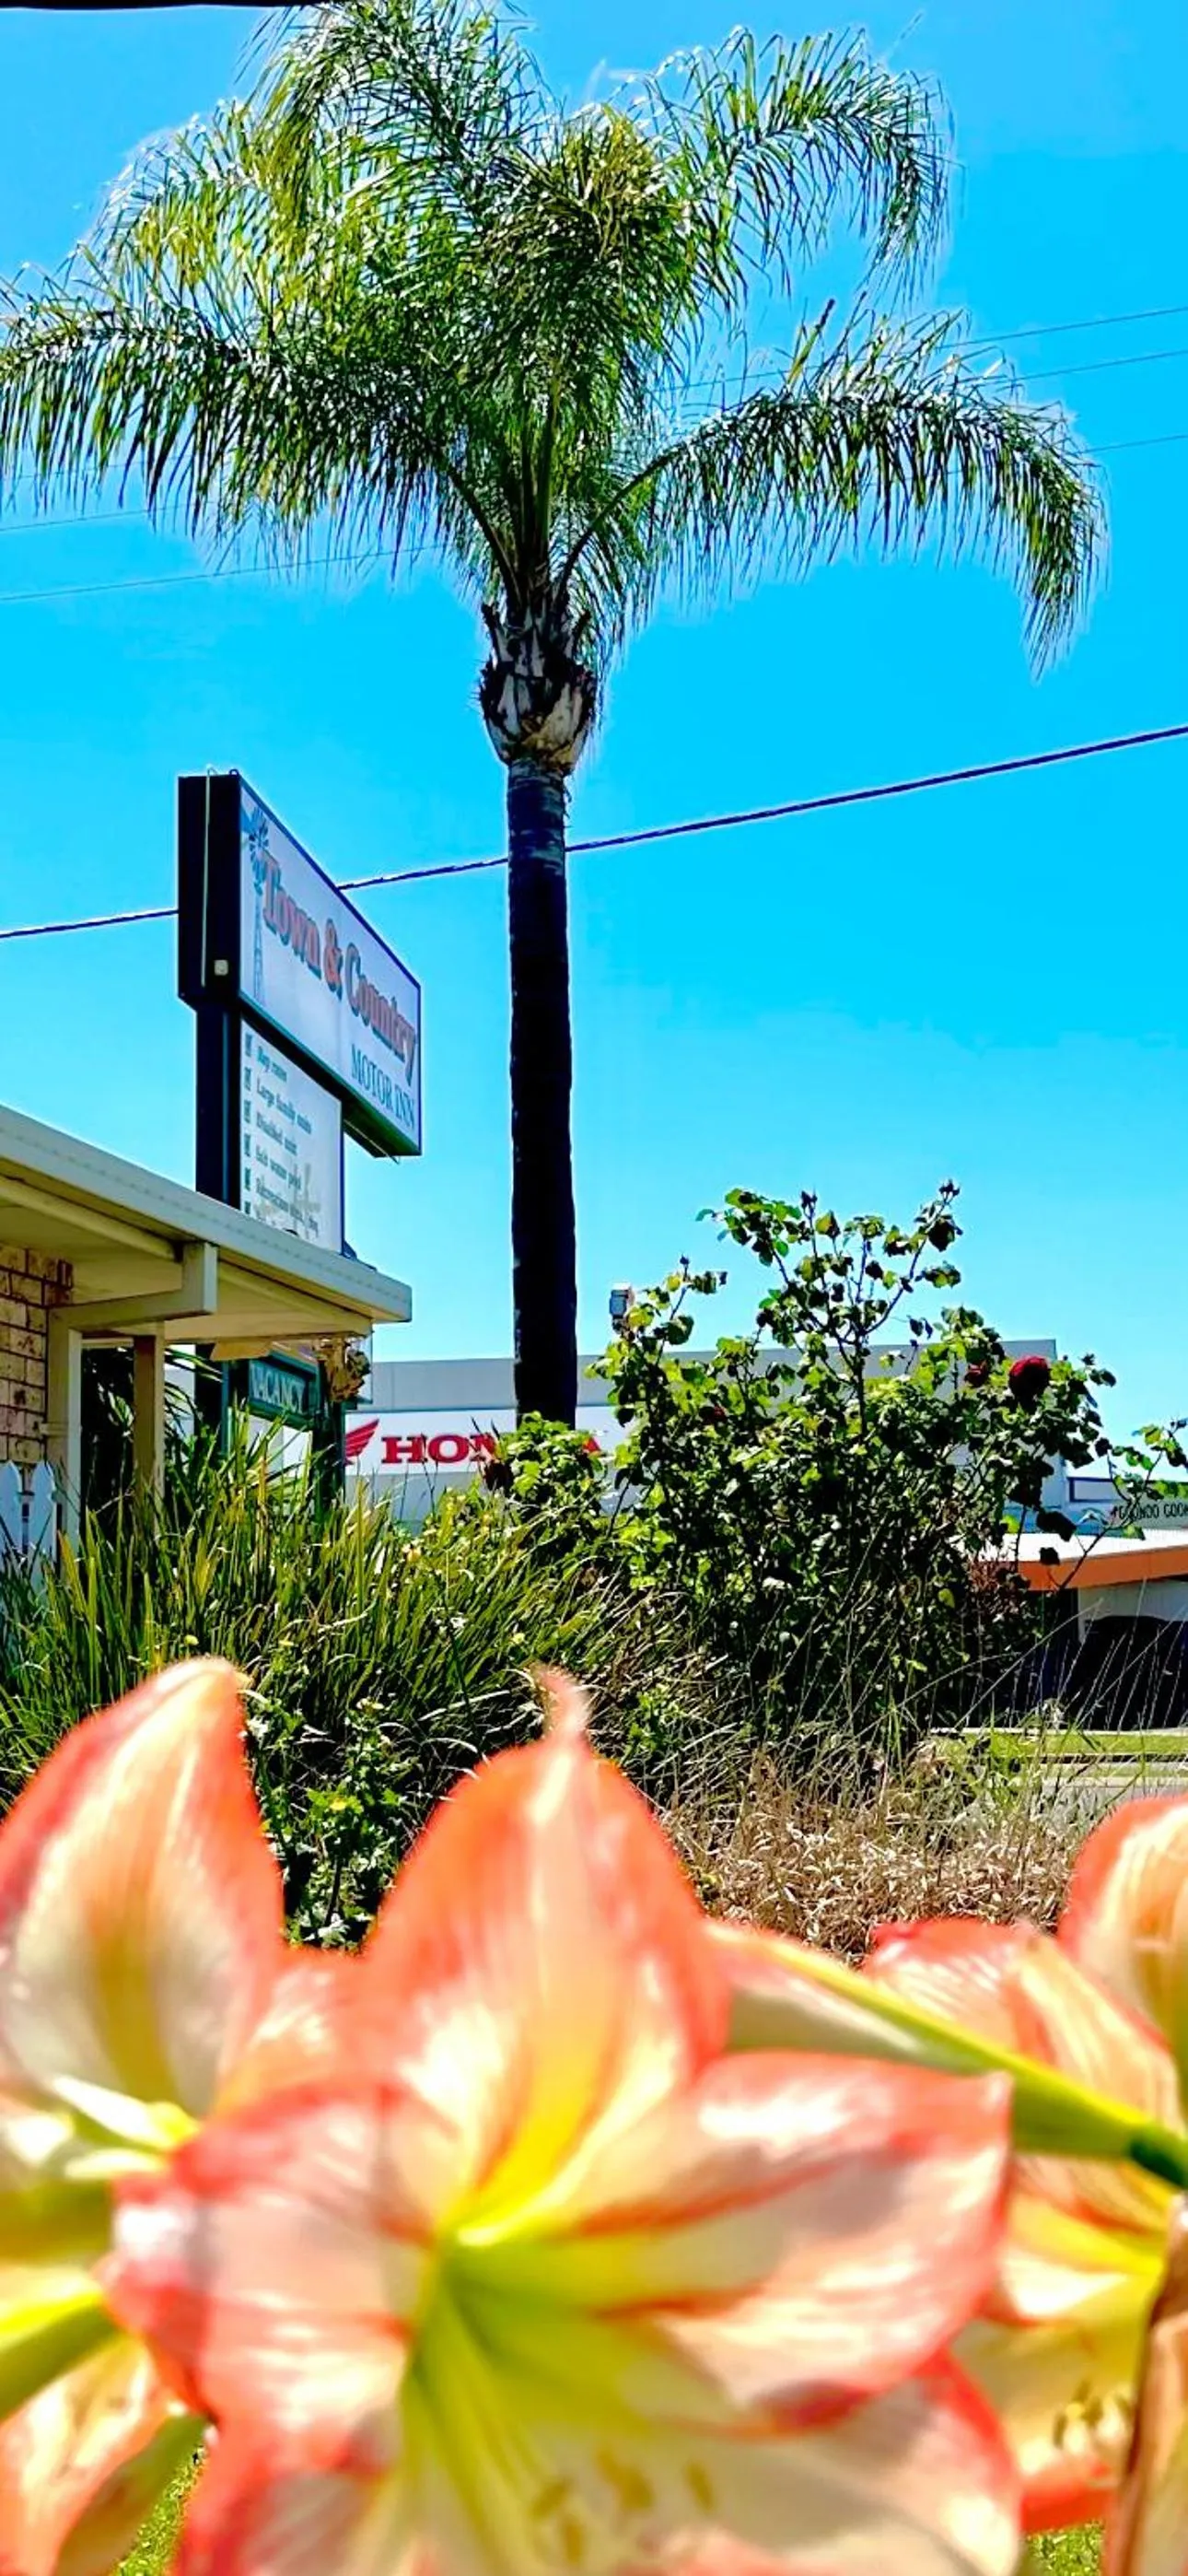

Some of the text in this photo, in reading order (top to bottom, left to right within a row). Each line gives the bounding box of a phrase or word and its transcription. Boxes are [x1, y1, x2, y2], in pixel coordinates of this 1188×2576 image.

[262, 849, 417, 1087] Town & Country
[351, 1043, 415, 1130] MOTOR INN
[250, 1364, 305, 1415] VACANCY
